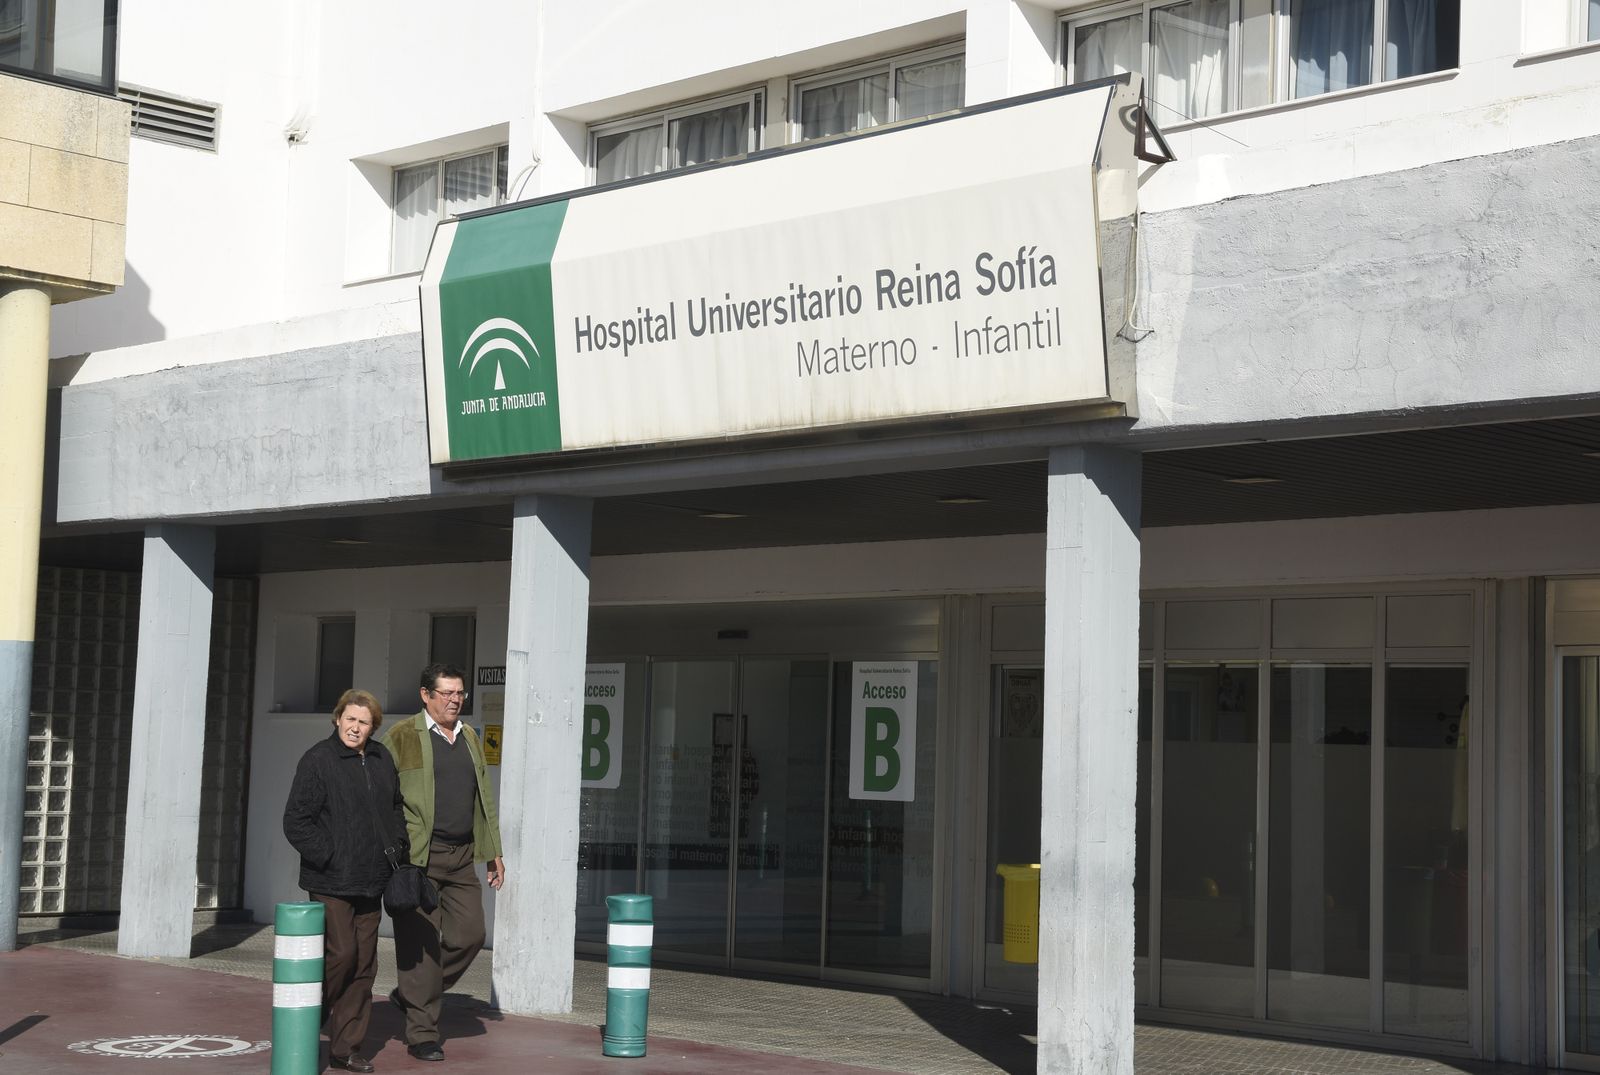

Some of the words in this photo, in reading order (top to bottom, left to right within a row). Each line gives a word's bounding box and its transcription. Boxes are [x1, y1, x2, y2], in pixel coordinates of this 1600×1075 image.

[575, 301, 677, 358] Hospital
[688, 276, 862, 337] Universitario
[876, 262, 961, 311] Reina
[976, 245, 1057, 296] Sofía
[798, 335, 917, 377] Materno
[955, 307, 1061, 359] Infantil
[461, 398, 486, 416] JUNTA
[488, 396, 500, 412] DE
[480, 669, 505, 683] VISITAS
[862, 681, 907, 700] Acceso
[863, 707, 901, 792] B
[679, 848, 724, 864] materno
